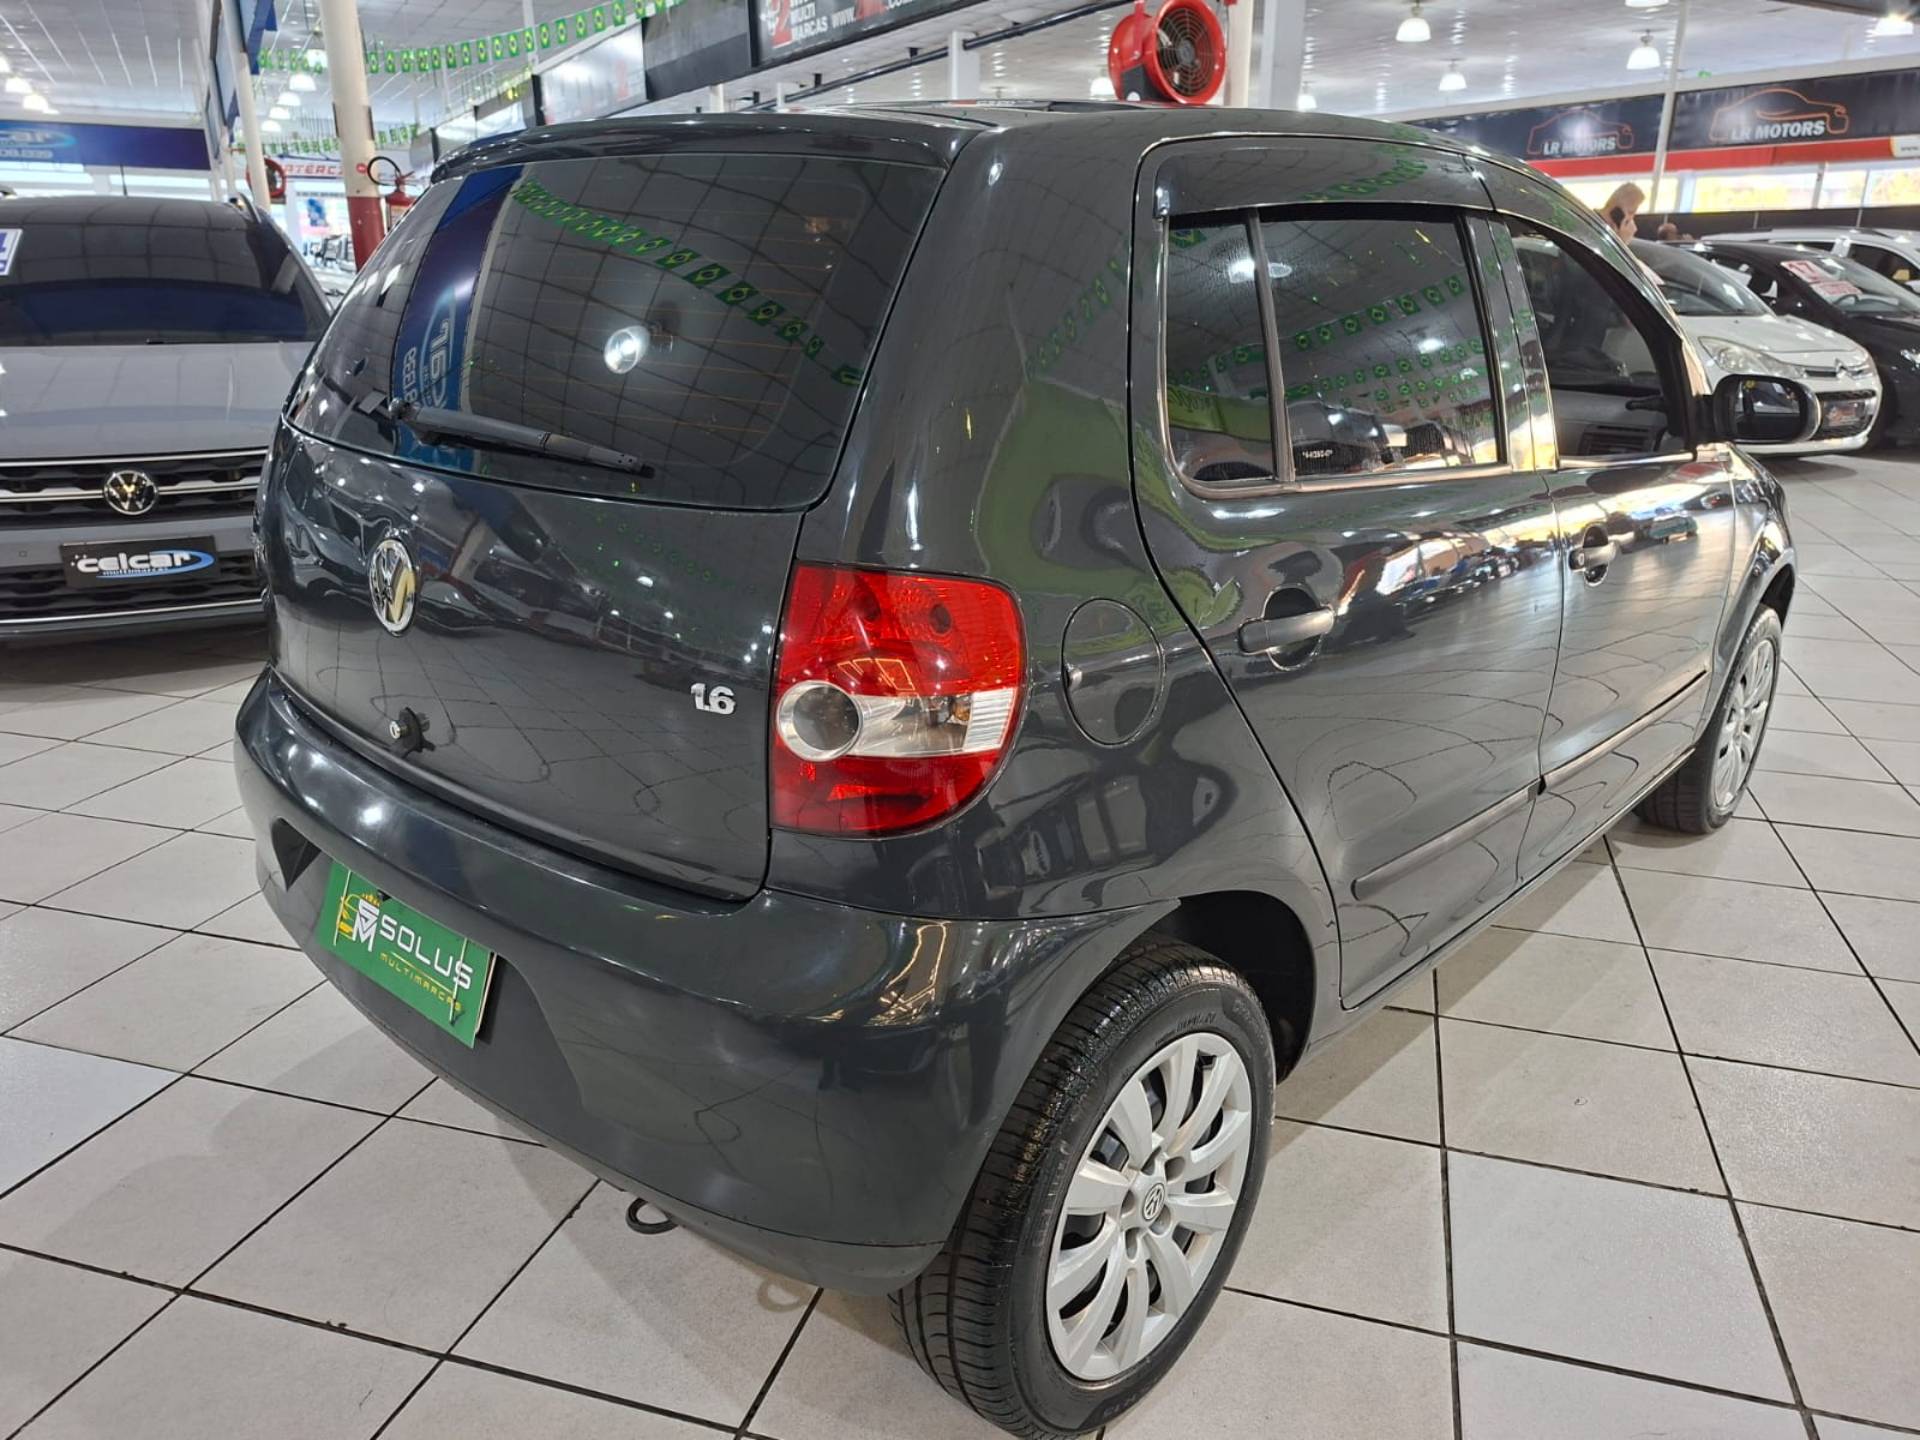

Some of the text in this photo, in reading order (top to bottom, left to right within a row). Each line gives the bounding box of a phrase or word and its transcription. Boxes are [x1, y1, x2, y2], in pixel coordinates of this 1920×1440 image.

[791, 15, 828, 42] MARCAS
[1755, 120, 1825, 139] MOTORS
[690, 683, 736, 715] 1.6
[379, 914, 473, 990] SOLUS
